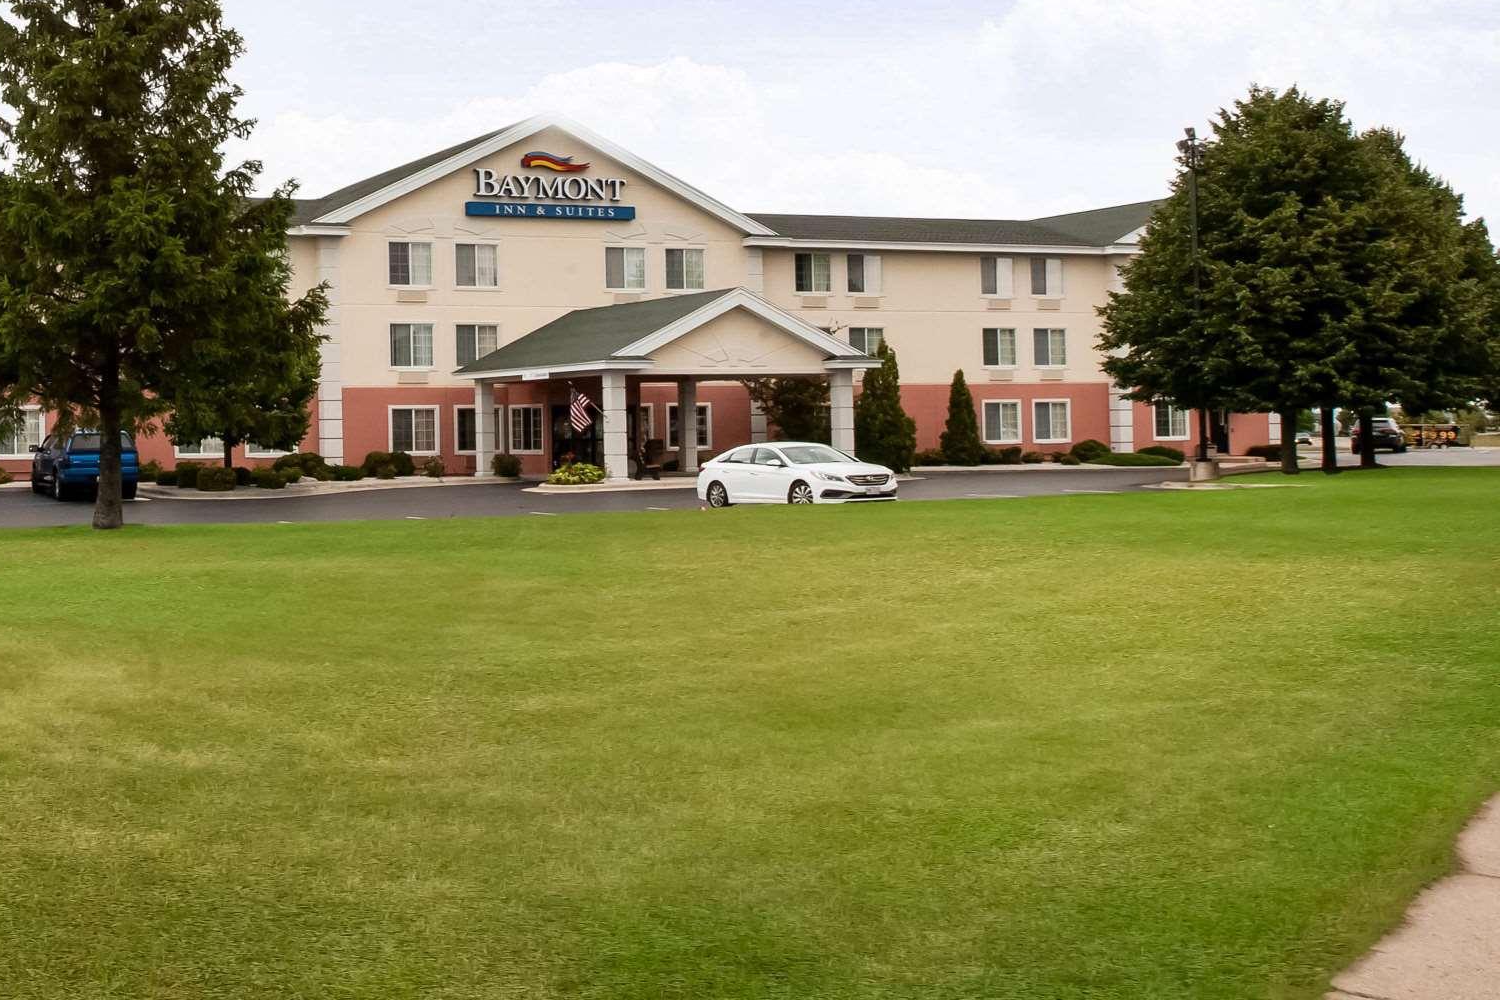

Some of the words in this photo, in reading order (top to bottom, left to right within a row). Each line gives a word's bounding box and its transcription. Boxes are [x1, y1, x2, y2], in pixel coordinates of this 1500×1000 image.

[475, 168, 626, 201] BAYMONT
[495, 205, 526, 215] INN
[536, 206, 546, 215] &
[556, 207, 615, 217] SUITES
